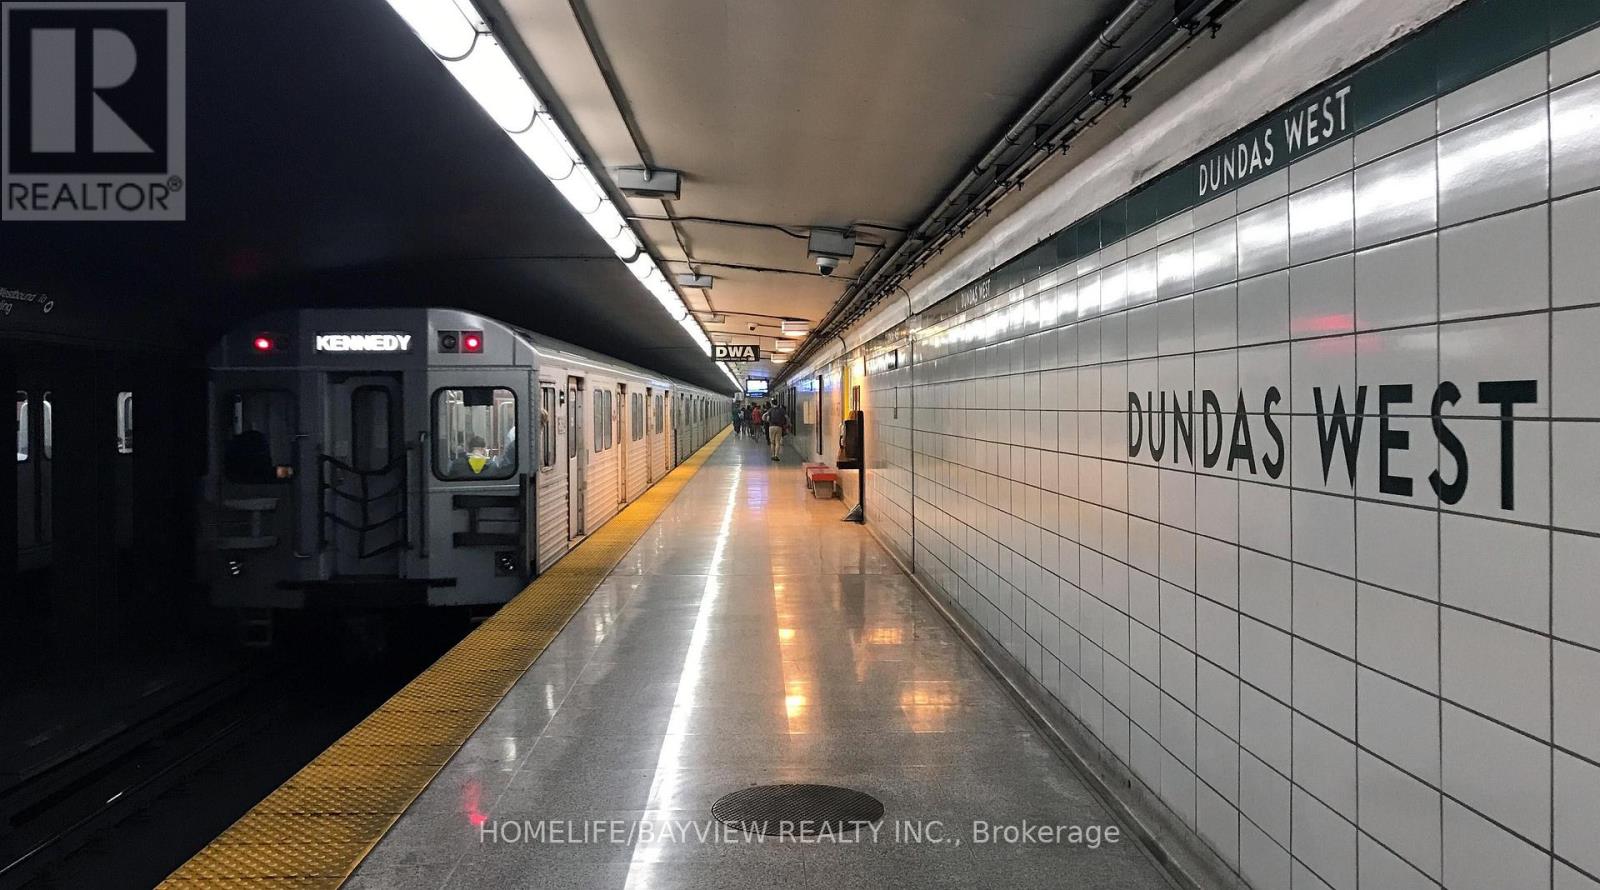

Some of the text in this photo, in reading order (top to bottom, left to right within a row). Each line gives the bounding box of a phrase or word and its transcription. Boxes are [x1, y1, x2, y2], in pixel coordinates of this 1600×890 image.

[1199, 85, 1351, 196] DUNDAS WEST
[316, 334, 412, 351] KENNEDY
[715, 345, 755, 358] DWA
[1128, 379, 1538, 511] DUNDAS WEST
